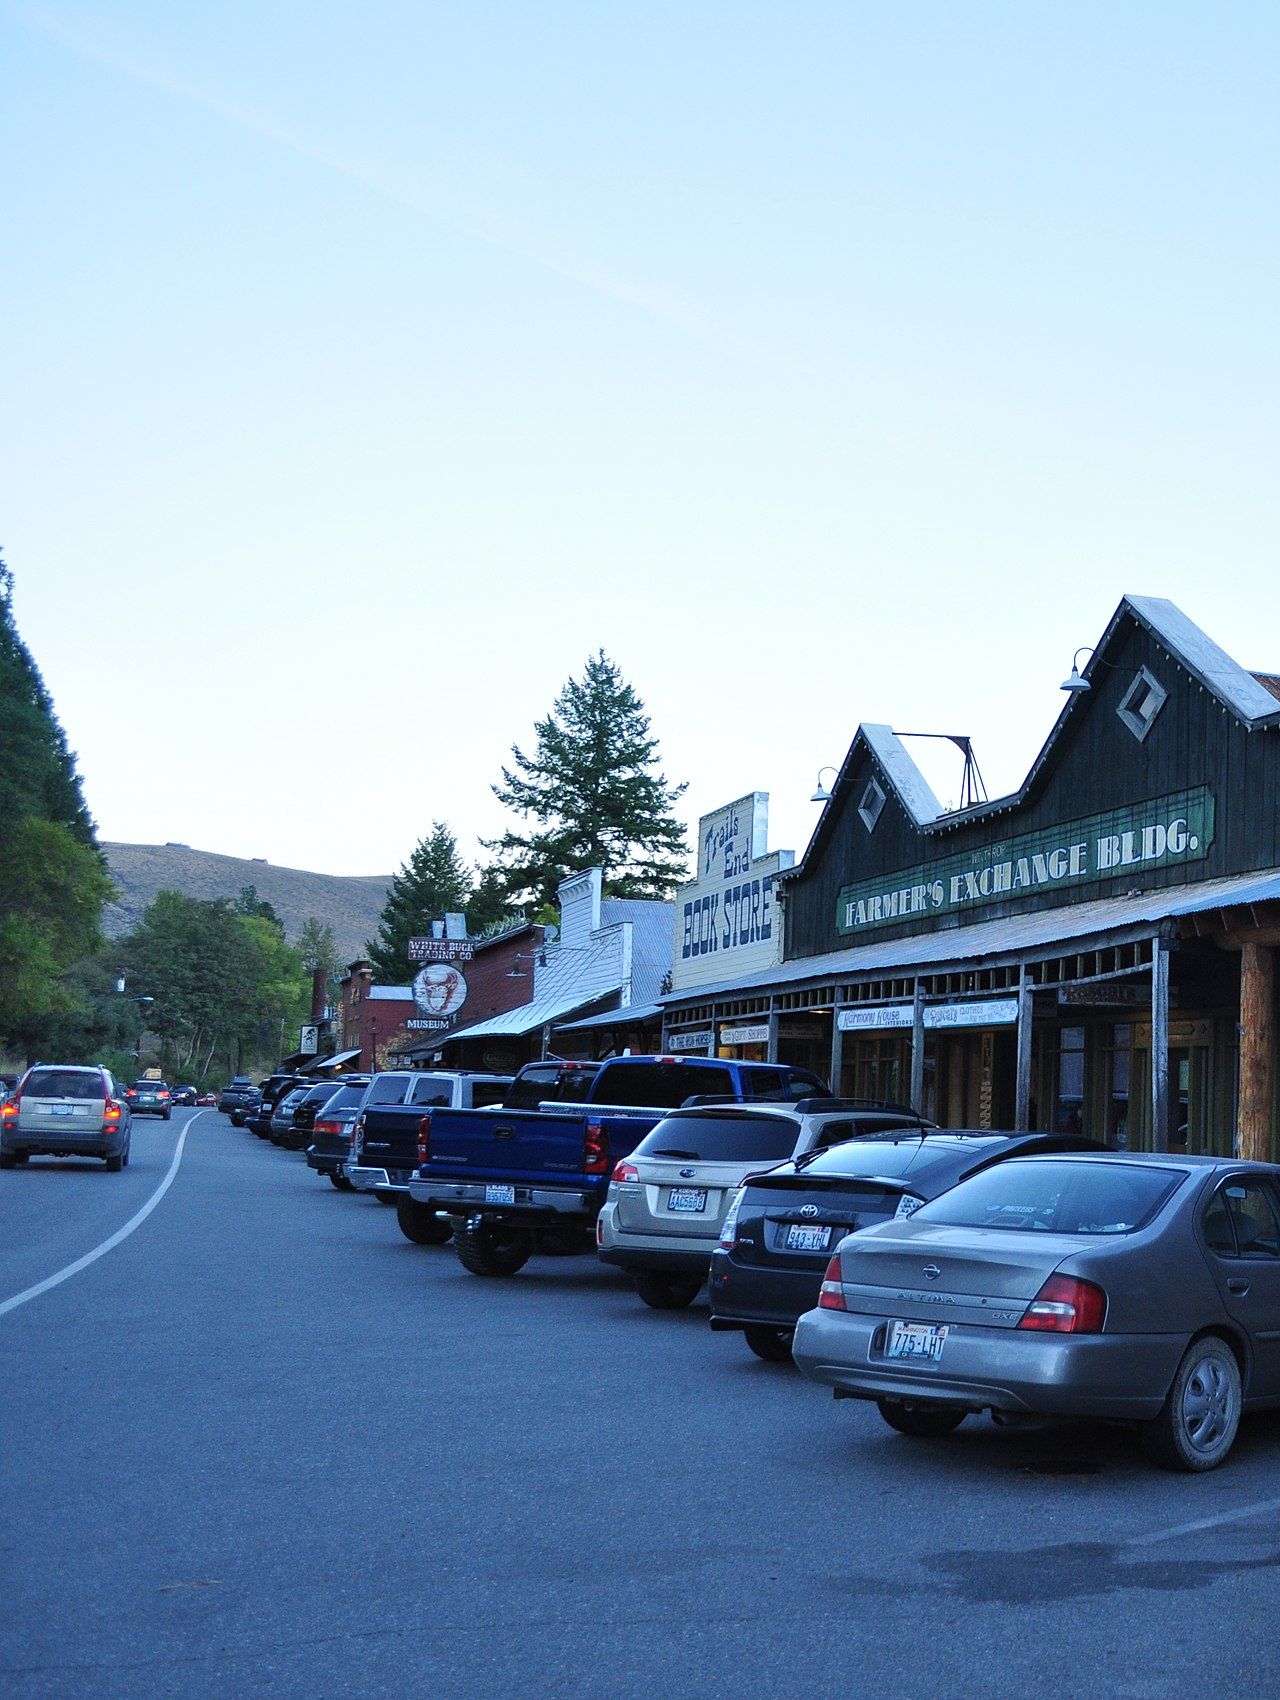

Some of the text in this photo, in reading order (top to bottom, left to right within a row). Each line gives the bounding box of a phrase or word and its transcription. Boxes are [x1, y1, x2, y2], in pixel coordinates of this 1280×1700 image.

[704, 809, 739, 876] Trail's
[724, 837, 750, 880] End
[844, 818, 1199, 928] FARMER'S EXCHANGE BLDG.
[682, 875, 773, 959] BOOK STORE
[410, 940, 474, 952] WHITE BUCK
[411, 949, 455, 959] TRADING
[406, 1019, 450, 1029] MUSEUM
[898, 1292, 956, 1304] ALTIMA
[992, 1312, 1019, 1321] GXE
